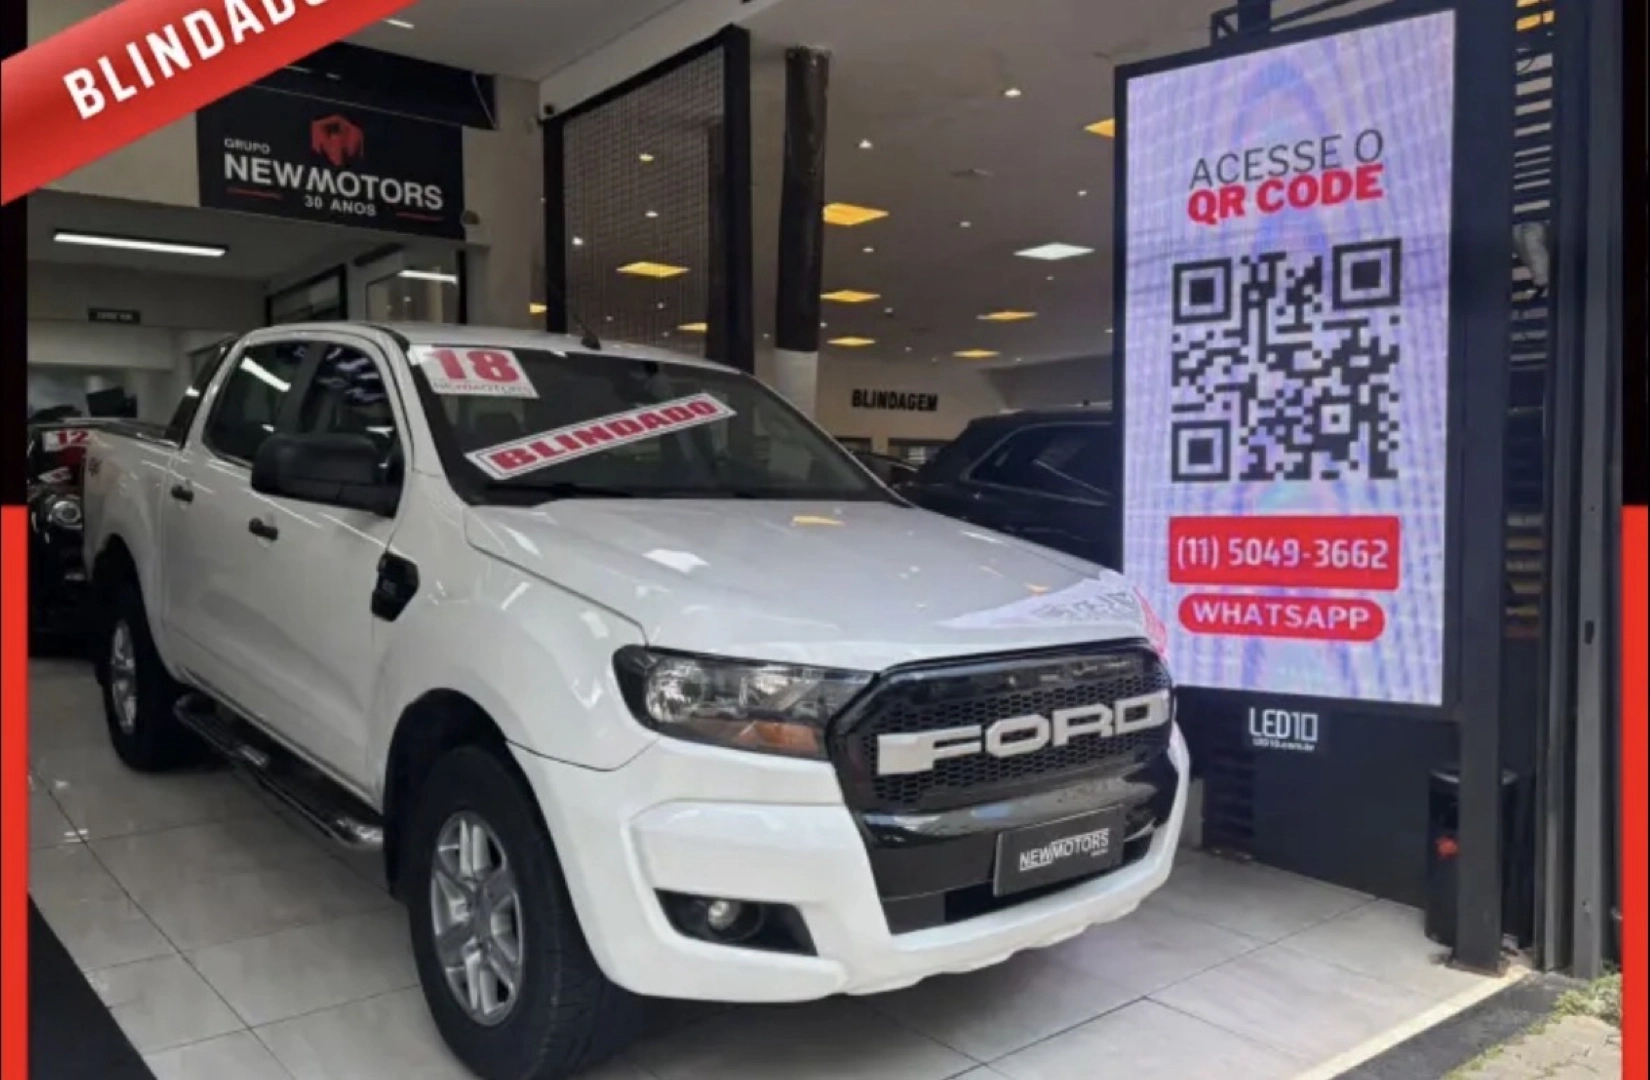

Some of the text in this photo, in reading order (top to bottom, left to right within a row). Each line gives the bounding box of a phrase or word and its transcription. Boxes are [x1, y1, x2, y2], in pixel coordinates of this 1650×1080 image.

[224, 138, 270, 154] GRUPO
[1189, 129, 1383, 190] ACESSE O
[224, 154, 443, 210] NEWMOTORS
[1187, 164, 1383, 225] QR CODE
[304, 195, 377, 217] 30 ANOS
[430, 349, 520, 383] 18
[851, 389, 938, 411] BLINDAGEM
[489, 400, 719, 470] BLINDADO
[1177, 536, 1389, 570] (11) 5049-3662
[1192, 601, 1370, 630] WHATSAPP
[877, 689, 1170, 775] FORD
[1249, 707, 1319, 743] LED10
[1019, 828, 1109, 869] NEWMOTORS
